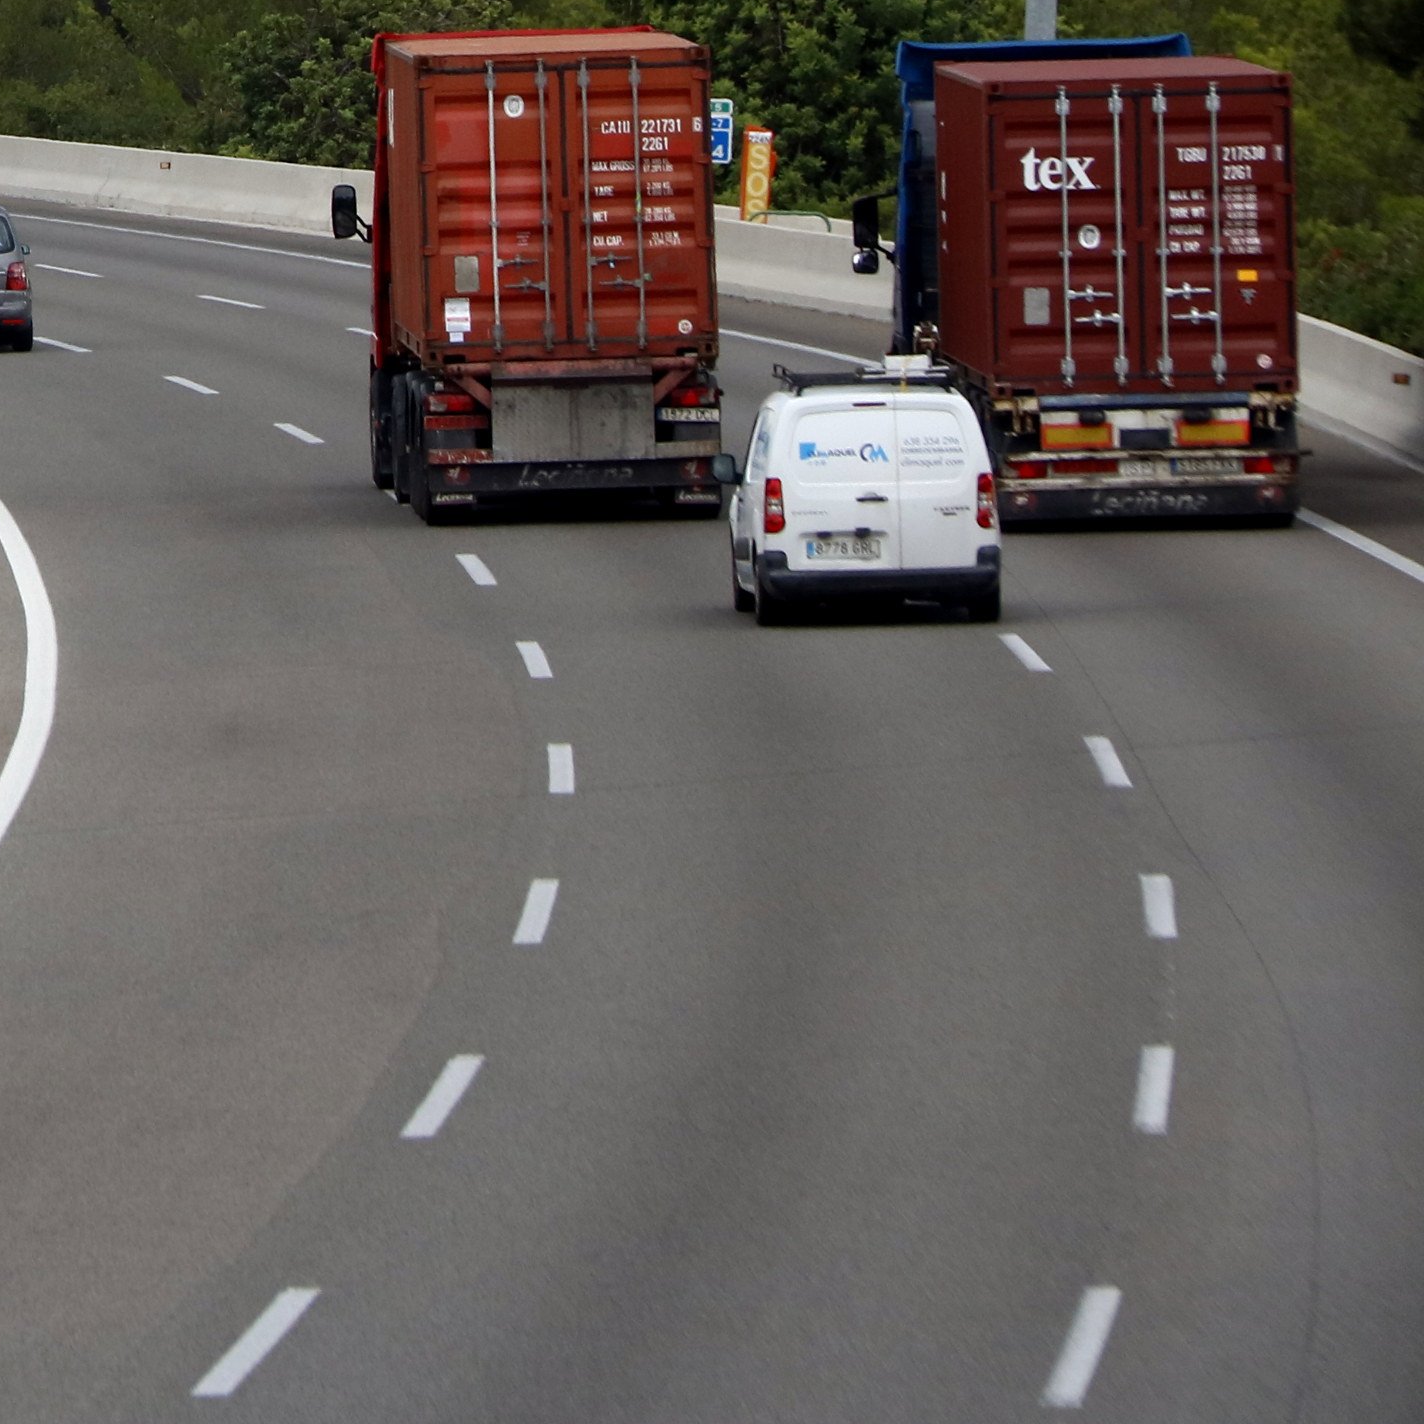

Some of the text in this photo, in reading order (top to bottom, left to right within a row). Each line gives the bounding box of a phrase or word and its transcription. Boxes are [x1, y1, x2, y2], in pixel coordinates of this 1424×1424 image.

[640, 118, 682, 133] 221731
[693, 117, 702, 131] 6
[1020, 146, 1096, 192] tex
[592, 210, 608, 222] NET
[815, 542, 849, 555] 8778
